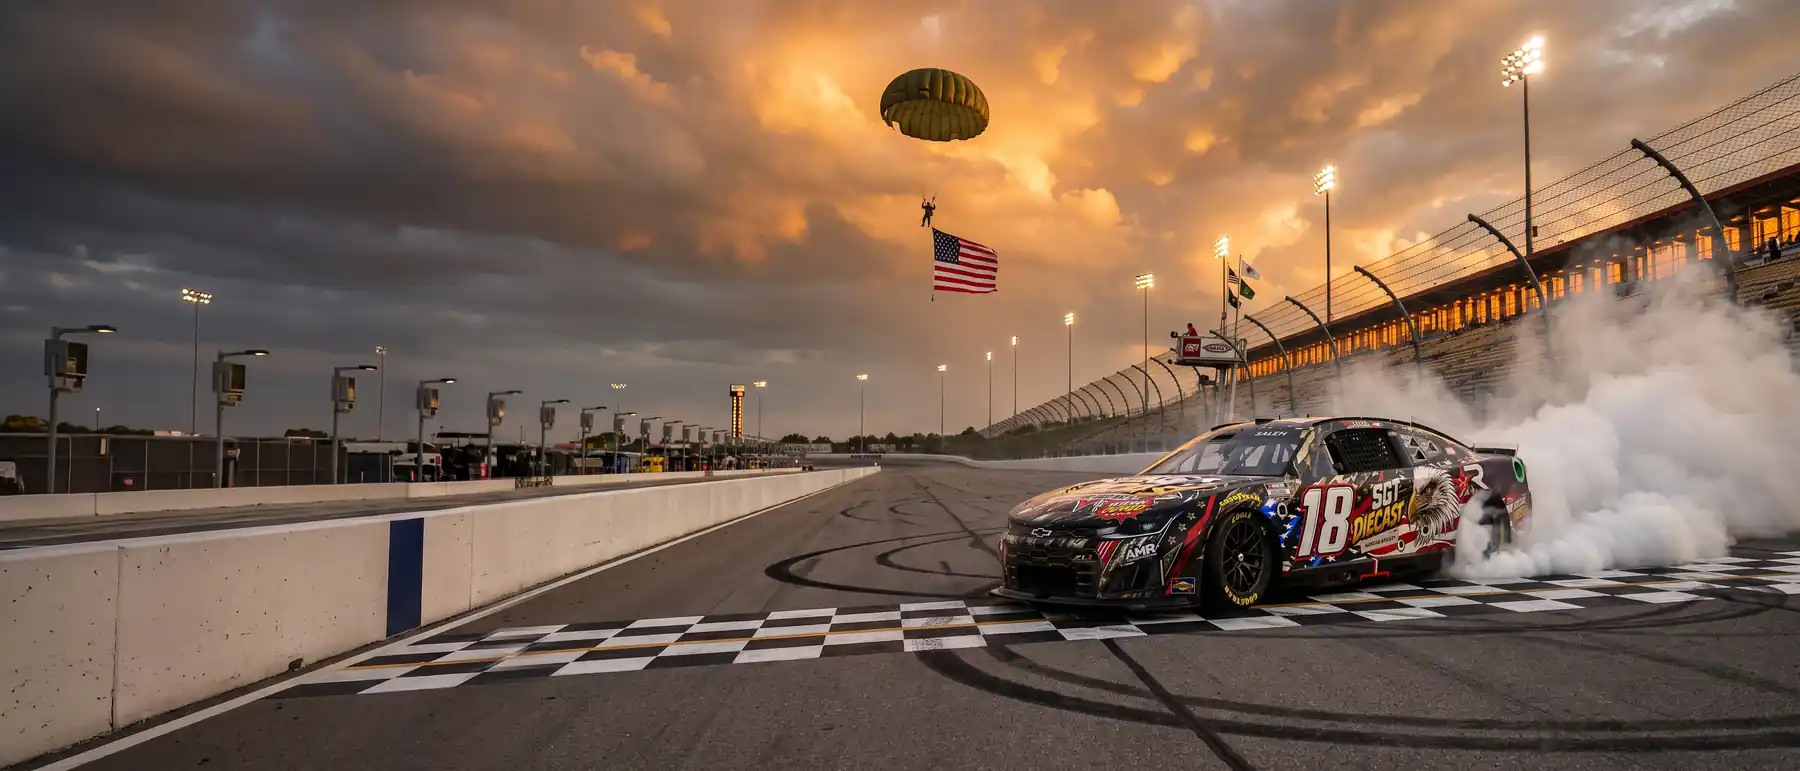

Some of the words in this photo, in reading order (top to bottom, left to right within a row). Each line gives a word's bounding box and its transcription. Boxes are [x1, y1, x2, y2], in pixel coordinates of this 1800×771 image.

[1219, 492, 1261, 507] GOODYEAR
[1371, 477, 1401, 510] SGT
[1297, 485, 1354, 557] 18
[1352, 500, 1405, 544] DIECAST
[1125, 543, 1156, 560] AMR
